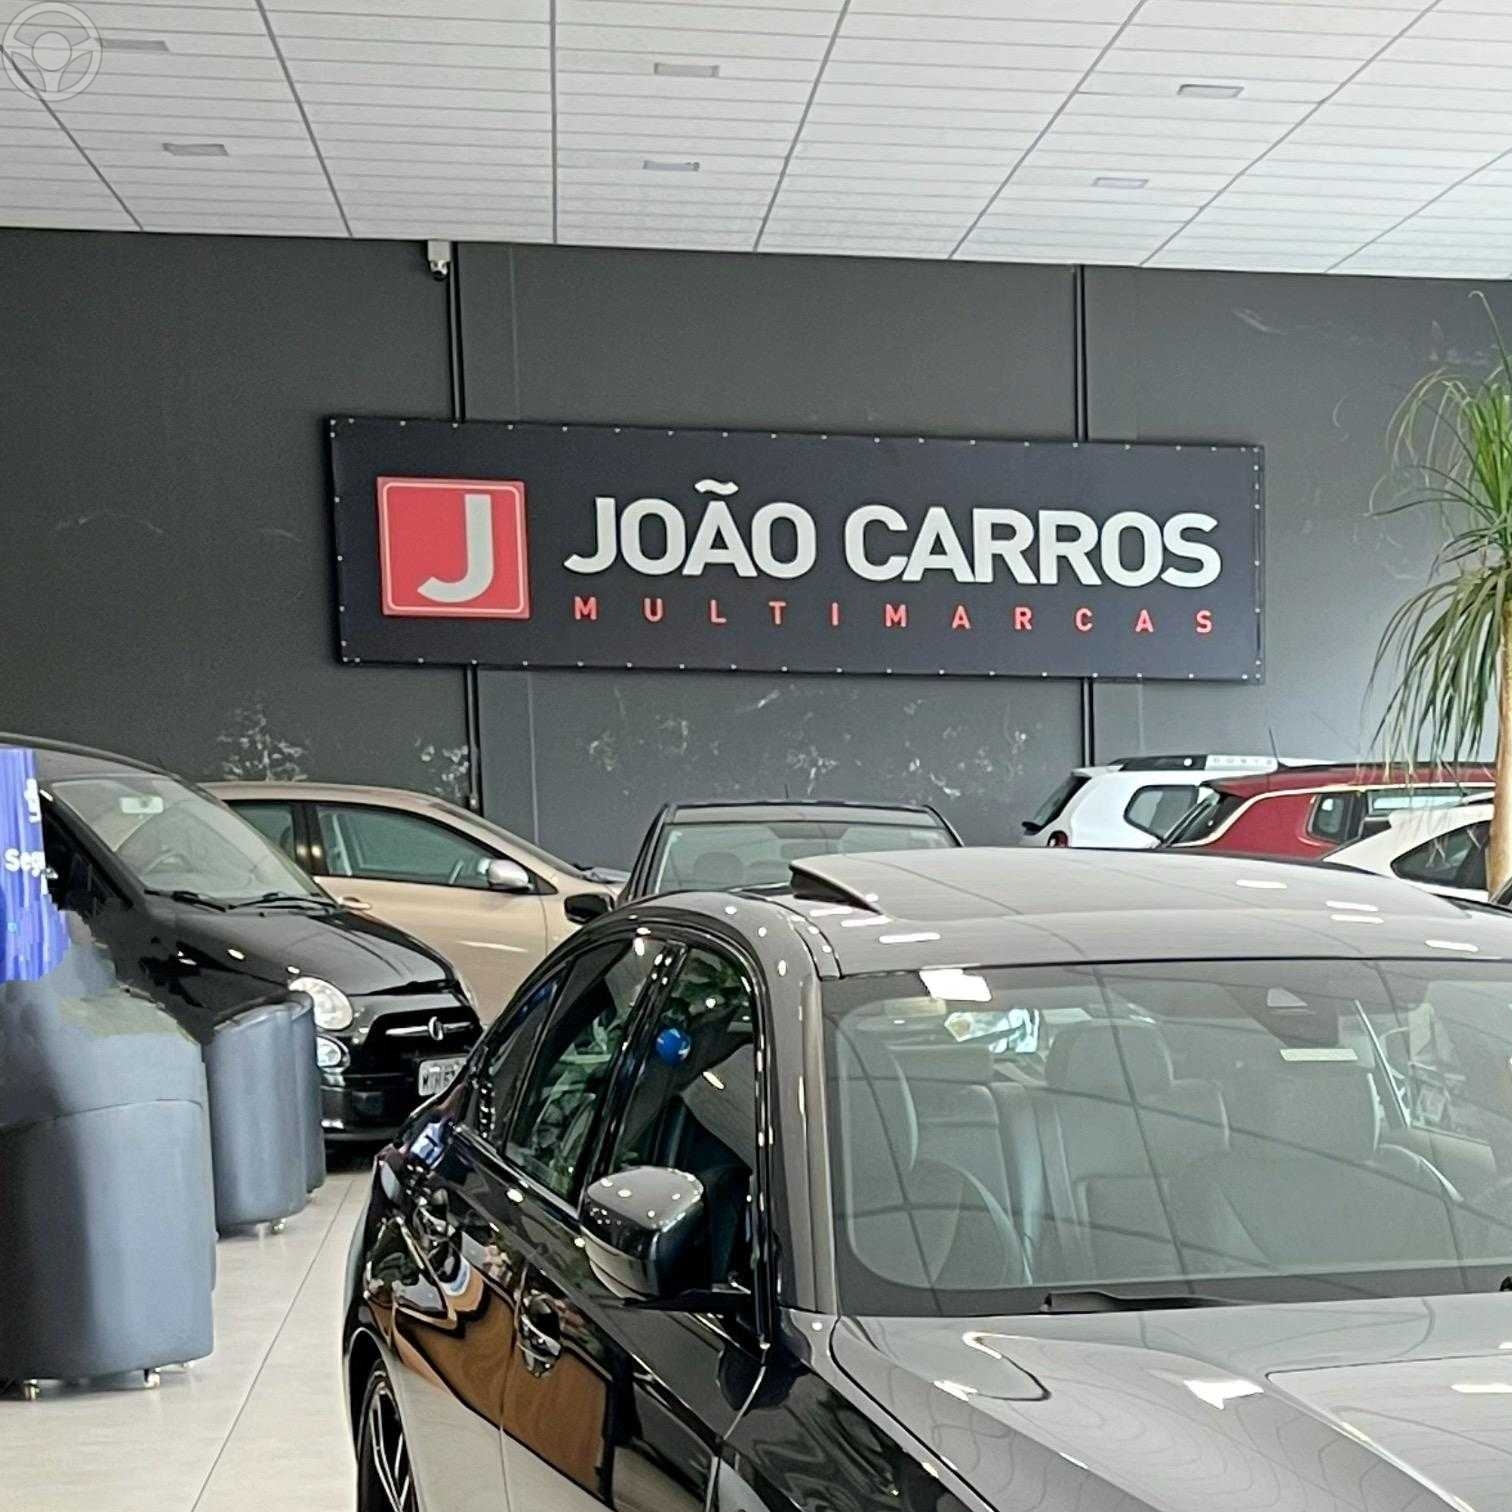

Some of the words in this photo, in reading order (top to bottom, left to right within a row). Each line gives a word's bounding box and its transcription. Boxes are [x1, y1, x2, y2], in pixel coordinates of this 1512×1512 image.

[416, 493, 494, 603] J
[563, 479, 817, 579] JOÃO
[844, 504, 1223, 588] CARROS
[574, 596, 1214, 634] MULTIMARCAS
